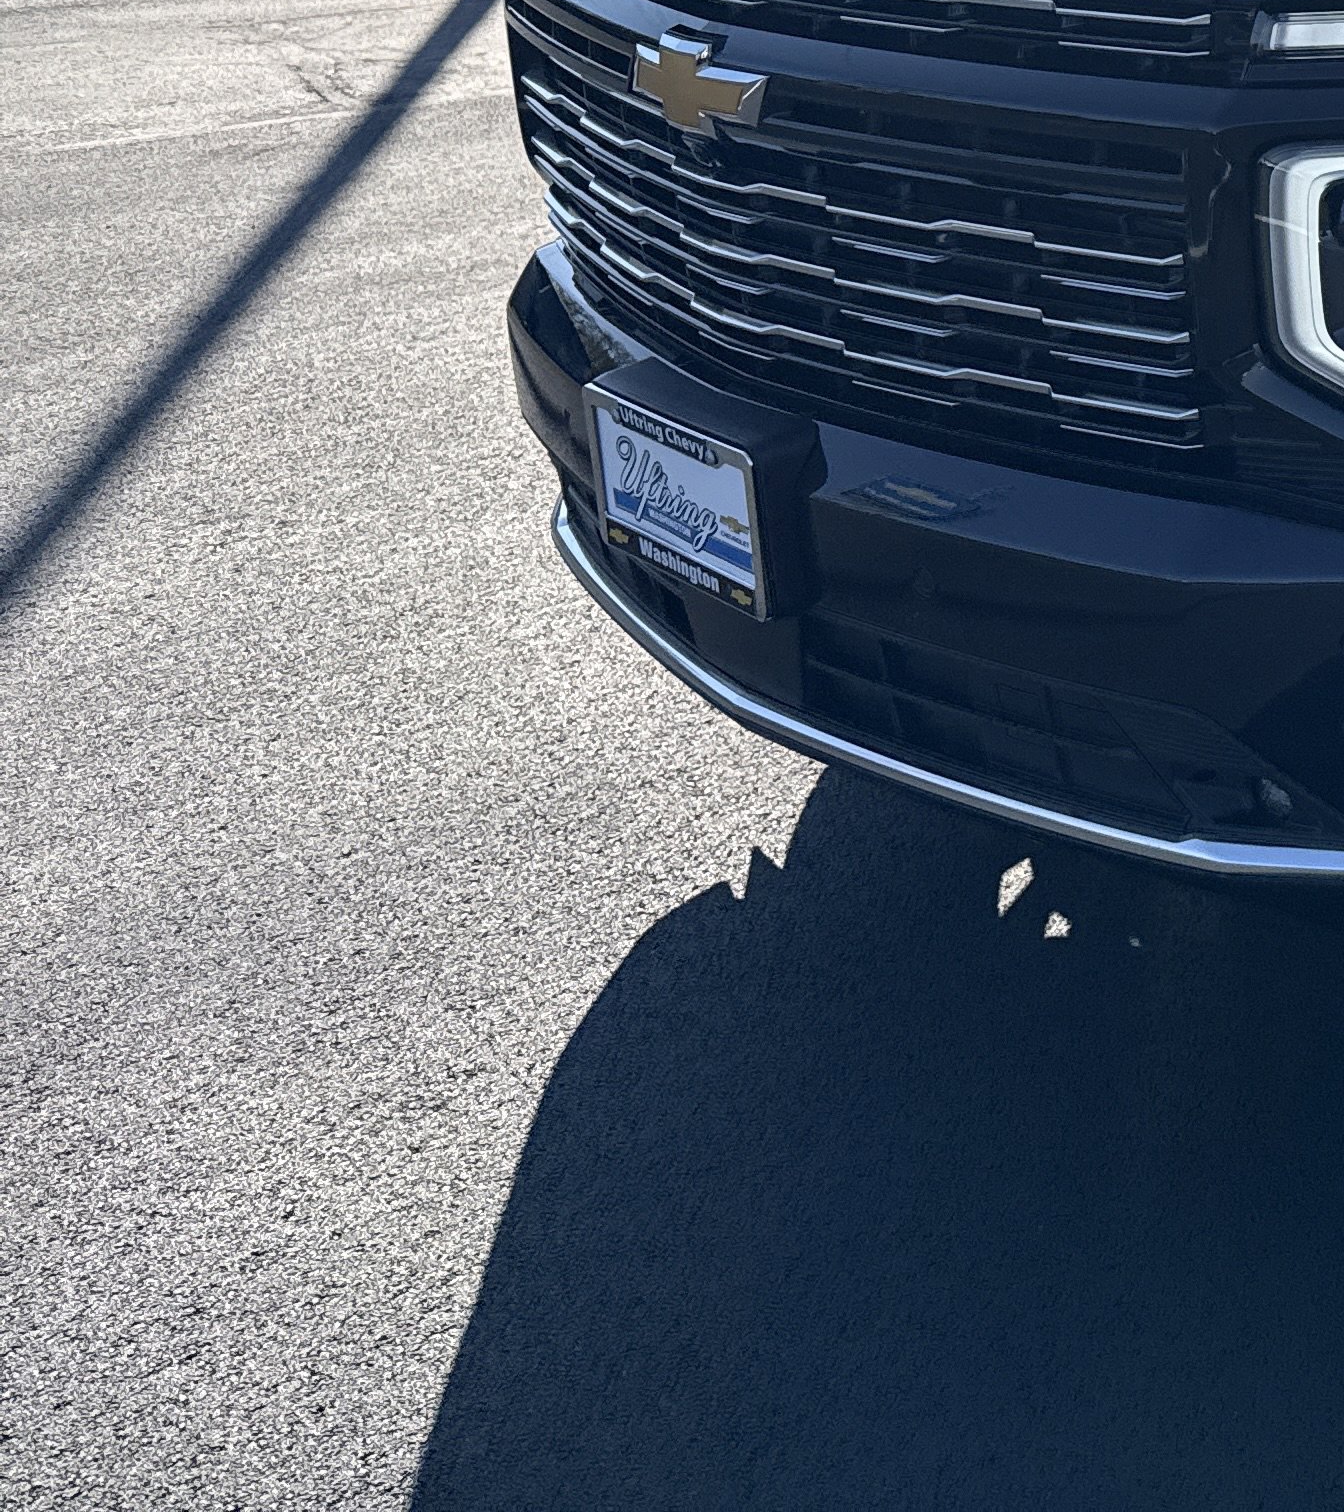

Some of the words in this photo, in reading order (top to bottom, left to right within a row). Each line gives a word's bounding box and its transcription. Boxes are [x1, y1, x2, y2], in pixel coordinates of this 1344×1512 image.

[619, 405, 664, 443] Uftring
[664, 427, 705, 461] Chevy
[616, 435, 719, 553] Uftring
[638, 537, 721, 594] Washington
